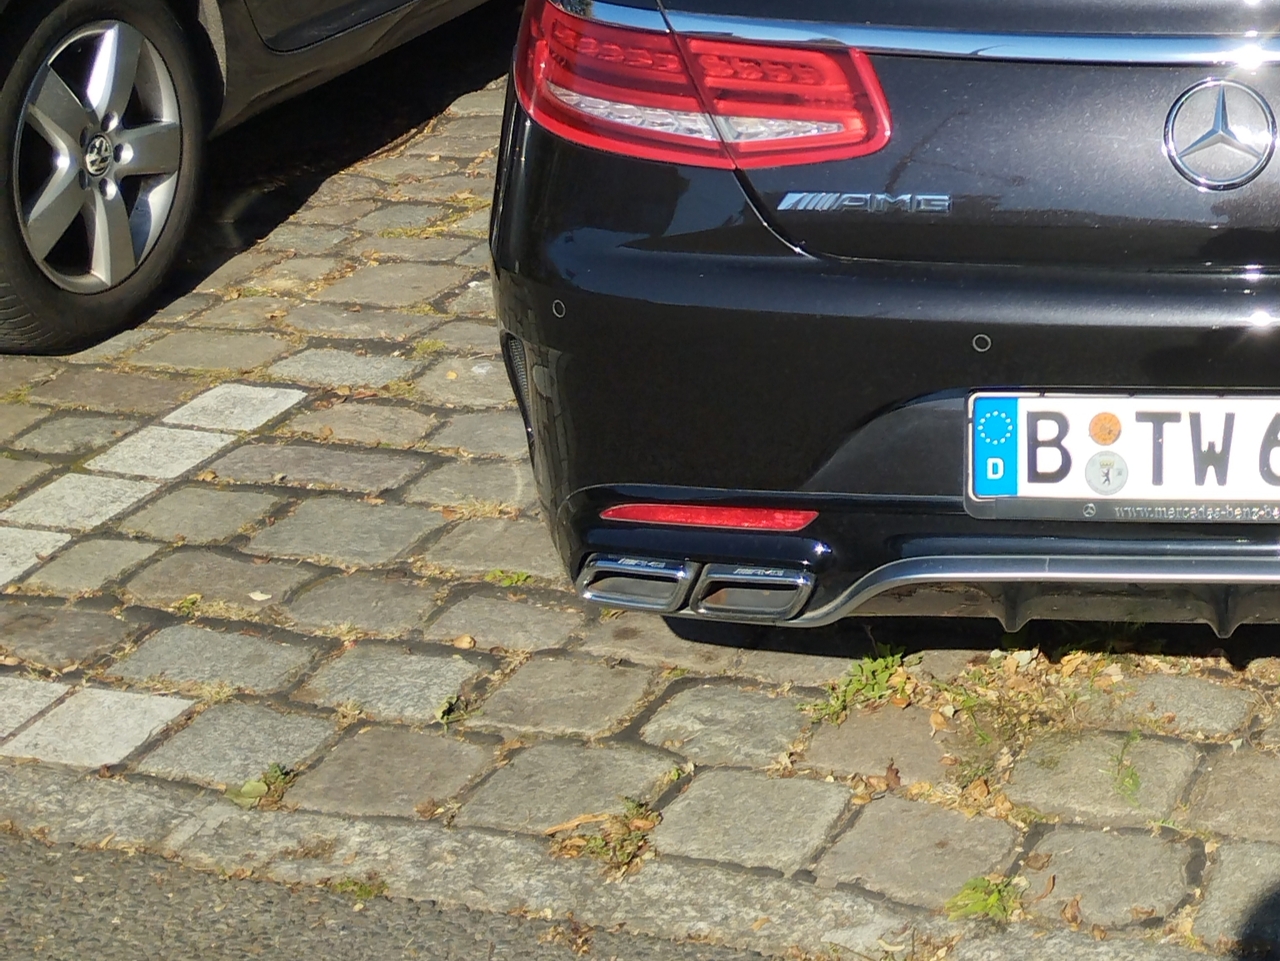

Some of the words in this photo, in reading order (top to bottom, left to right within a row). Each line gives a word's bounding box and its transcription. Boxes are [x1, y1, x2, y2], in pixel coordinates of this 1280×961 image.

[830, 193, 952, 213] AMG
[1026, 411, 1072, 484] B
[1135, 411, 1236, 486] TW
[986, 457, 1004, 481] D
